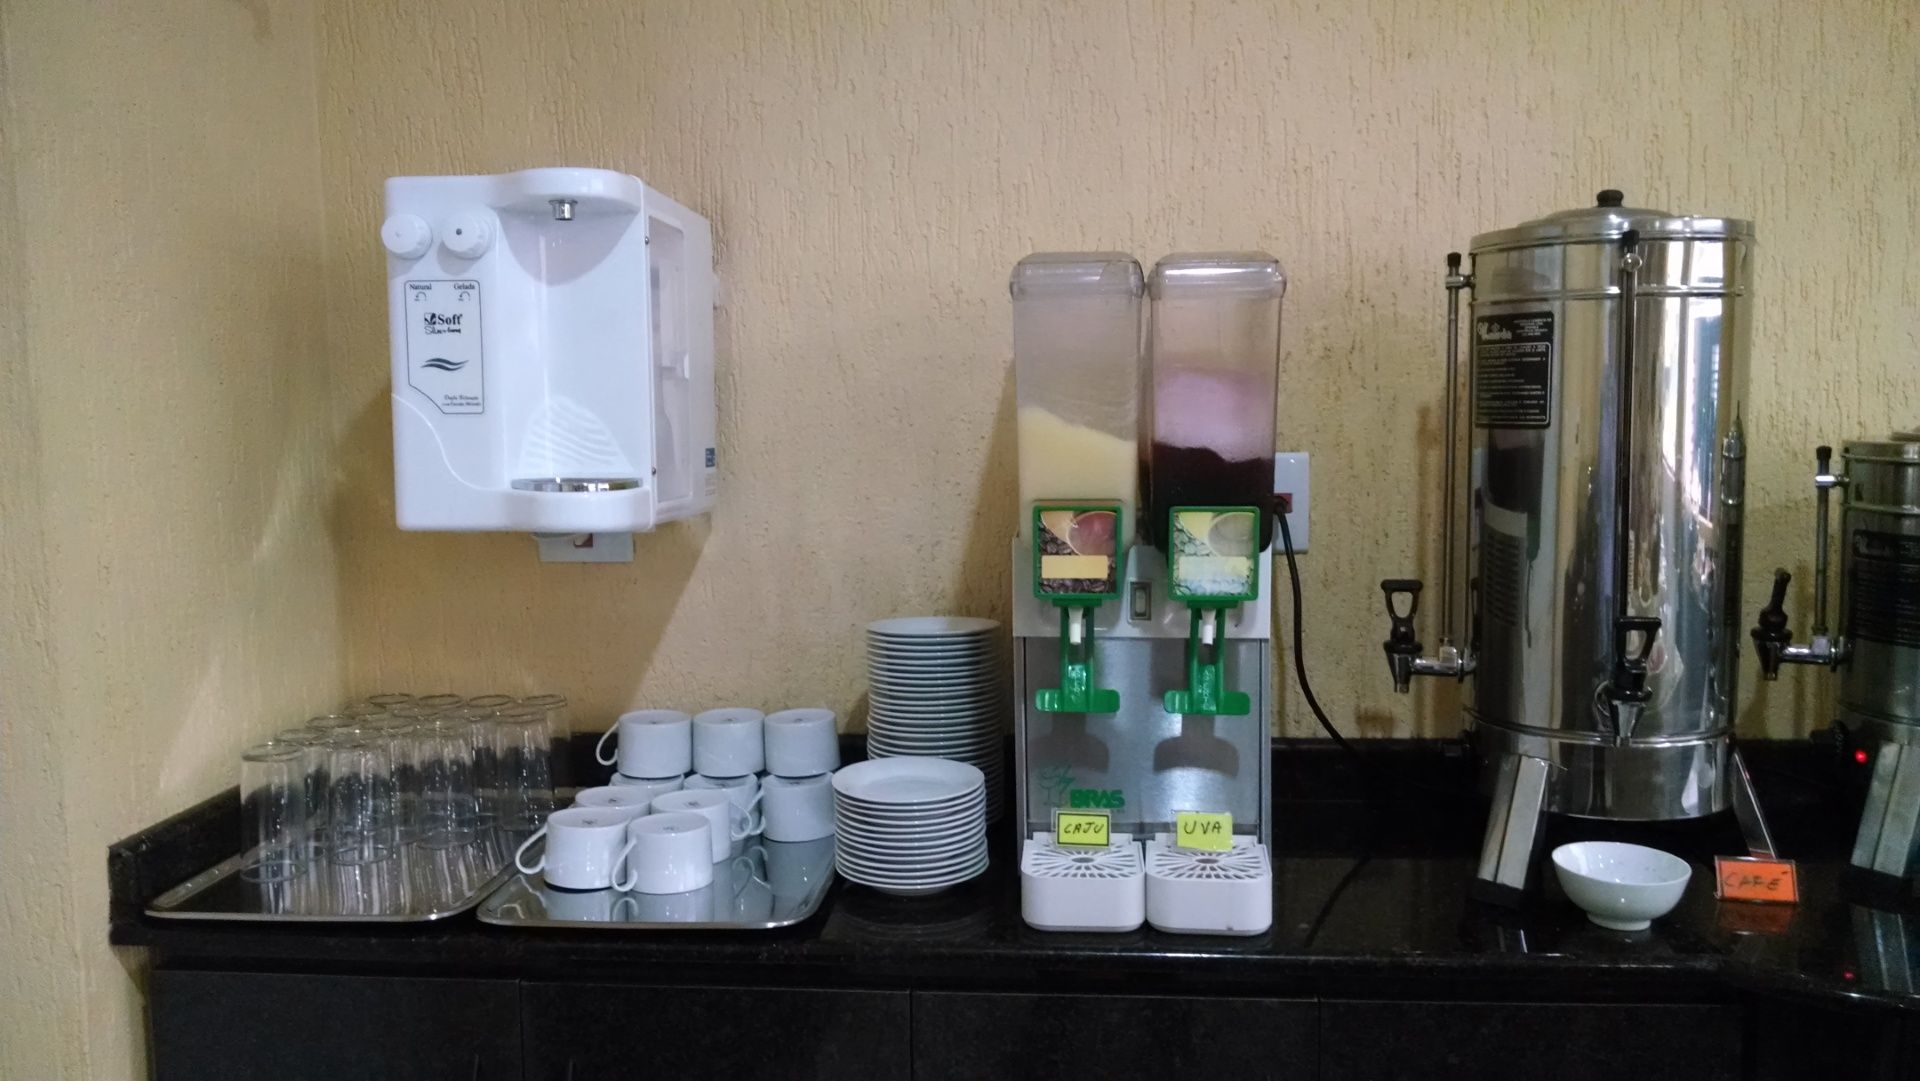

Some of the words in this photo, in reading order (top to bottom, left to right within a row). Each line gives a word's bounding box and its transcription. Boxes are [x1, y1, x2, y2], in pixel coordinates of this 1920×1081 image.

[437, 313, 463, 325] Soft
[1070, 789, 1125, 809] BRAS
[1064, 821, 1105, 835] CAJU
[1183, 819, 1222, 835] UVA
